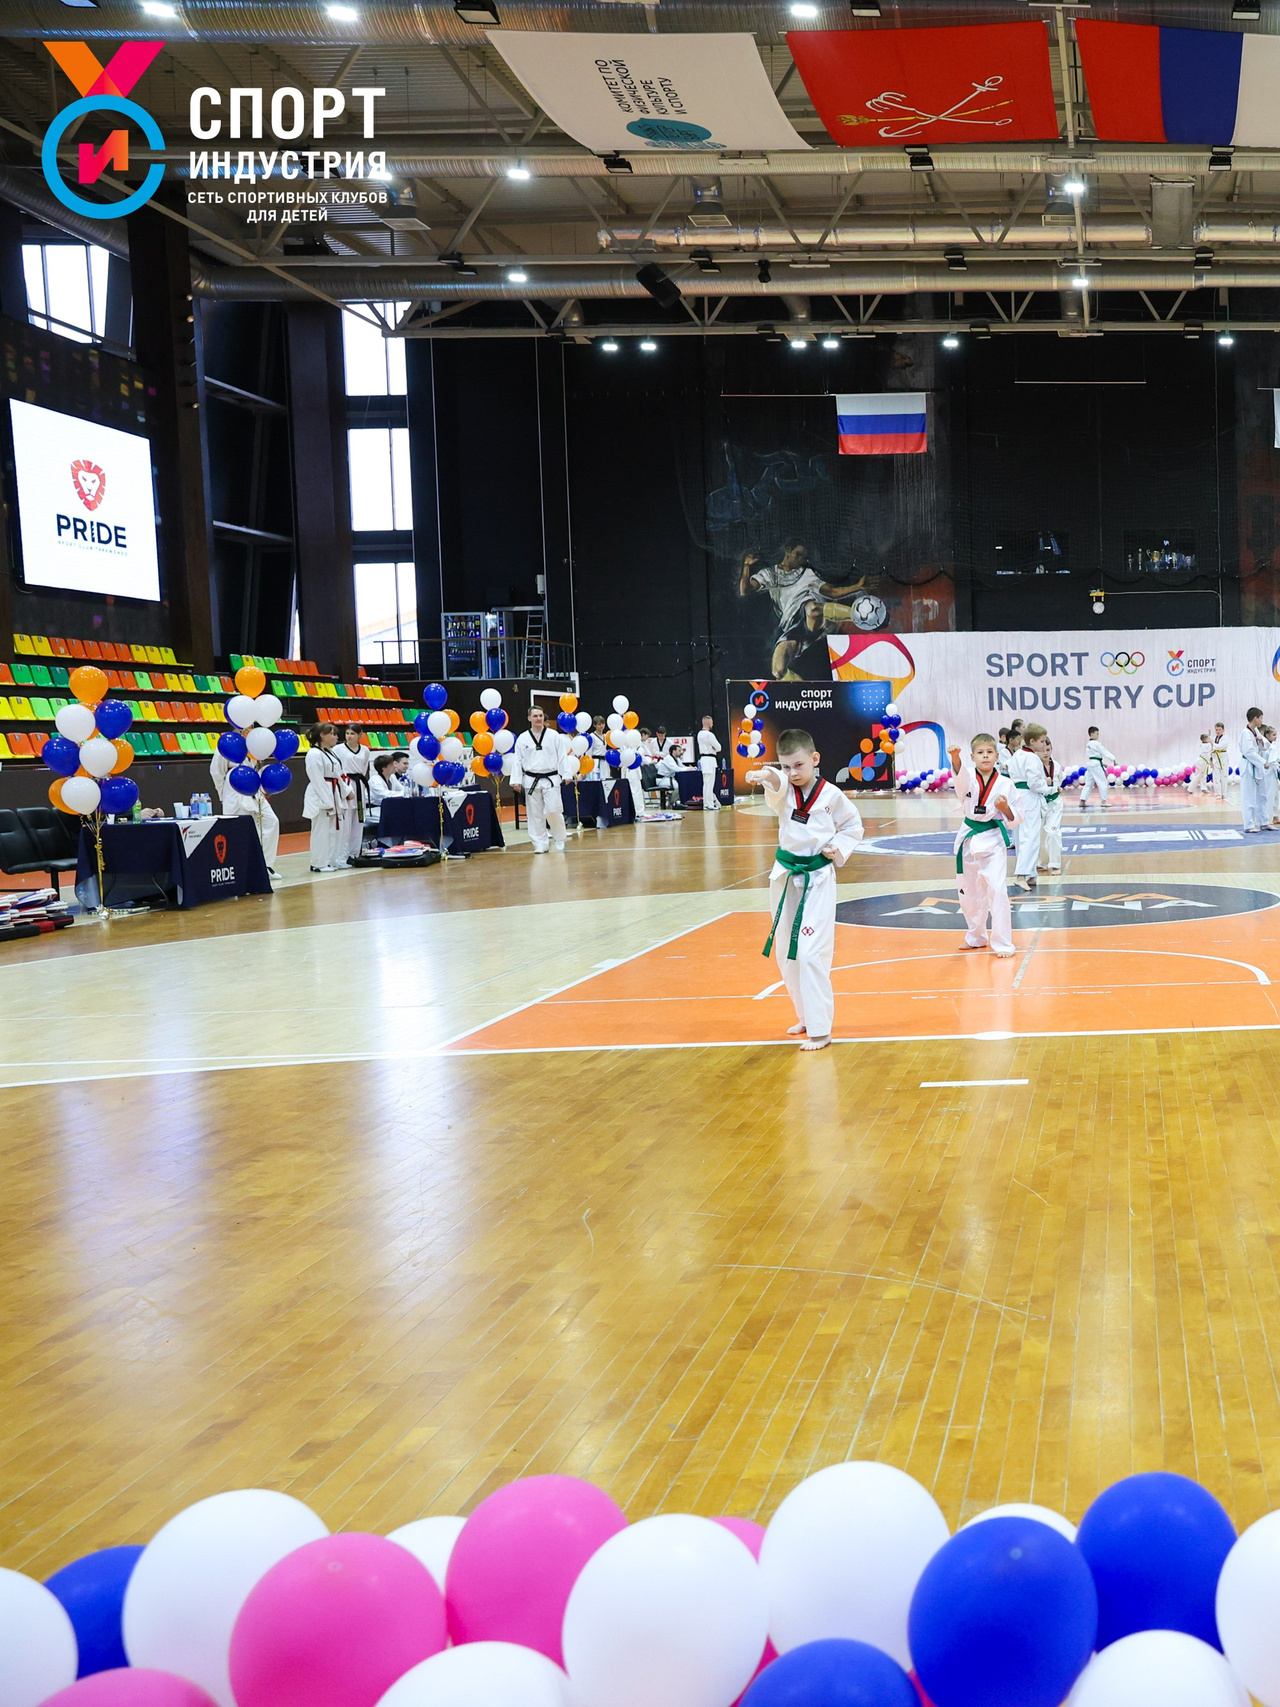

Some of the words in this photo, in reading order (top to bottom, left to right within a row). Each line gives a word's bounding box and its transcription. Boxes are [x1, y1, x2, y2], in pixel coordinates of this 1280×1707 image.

[594, 59, 613, 74] ПО
[602, 75, 634, 113] КОМИТЕТ
[608, 59, 650, 114] ФИЗИЧЕСКОЙ
[640, 79, 669, 115] КУЛЬТУРЕ
[657, 76, 684, 109] СПОРТУ
[56, 513, 127, 549] PRIDE
[985, 651, 1090, 677] SPORT
[1187, 658, 1216, 668] СПОРТ
[800, 689, 832, 700] спорт
[988, 684, 1144, 711] INDUSTRY
[1152, 682, 1216, 709] CUP
[775, 700, 833, 711] индустрия
[463, 826, 479, 839] PRIDE
[210, 866, 235, 883] PRIDE
[878, 900, 1220, 917] AENA
